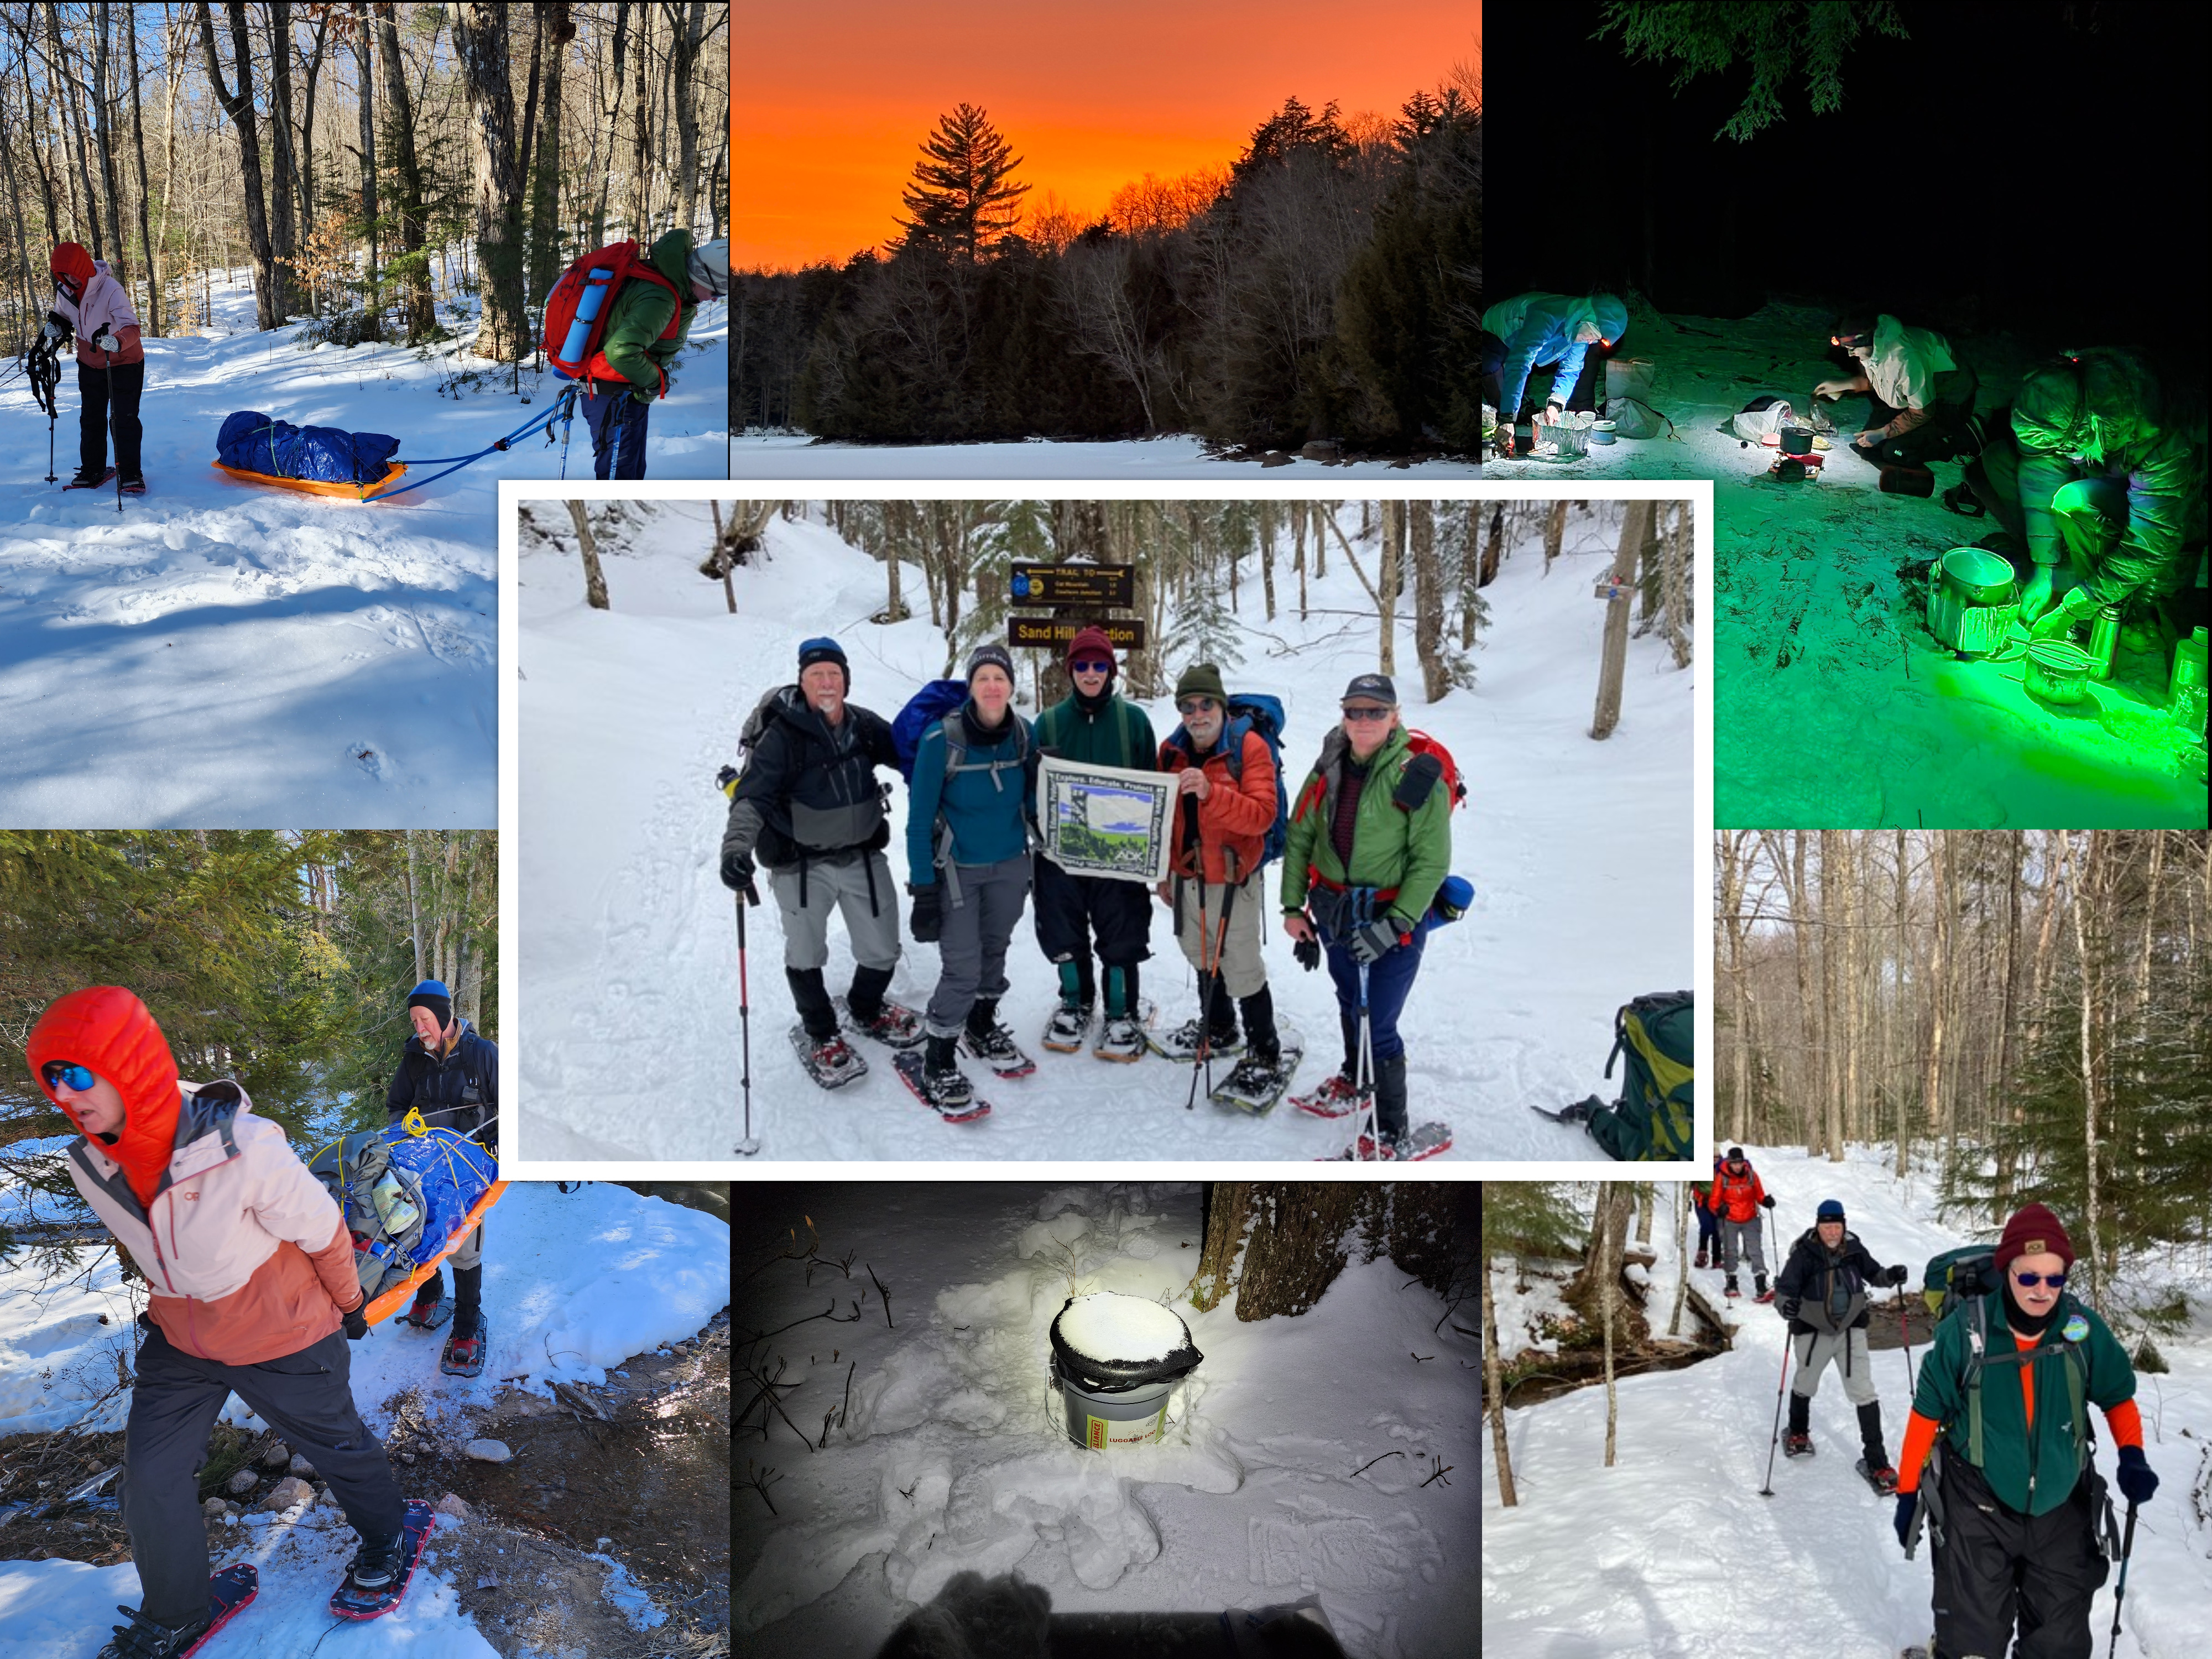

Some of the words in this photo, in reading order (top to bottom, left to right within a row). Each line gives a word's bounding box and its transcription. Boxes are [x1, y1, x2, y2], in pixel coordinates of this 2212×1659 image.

[1019, 624, 1051, 639] Sand
[1055, 625, 1076, 640] Hill
[184, 1192, 200, 1201] OR
[1145, 1430, 1156, 1438] LOO
